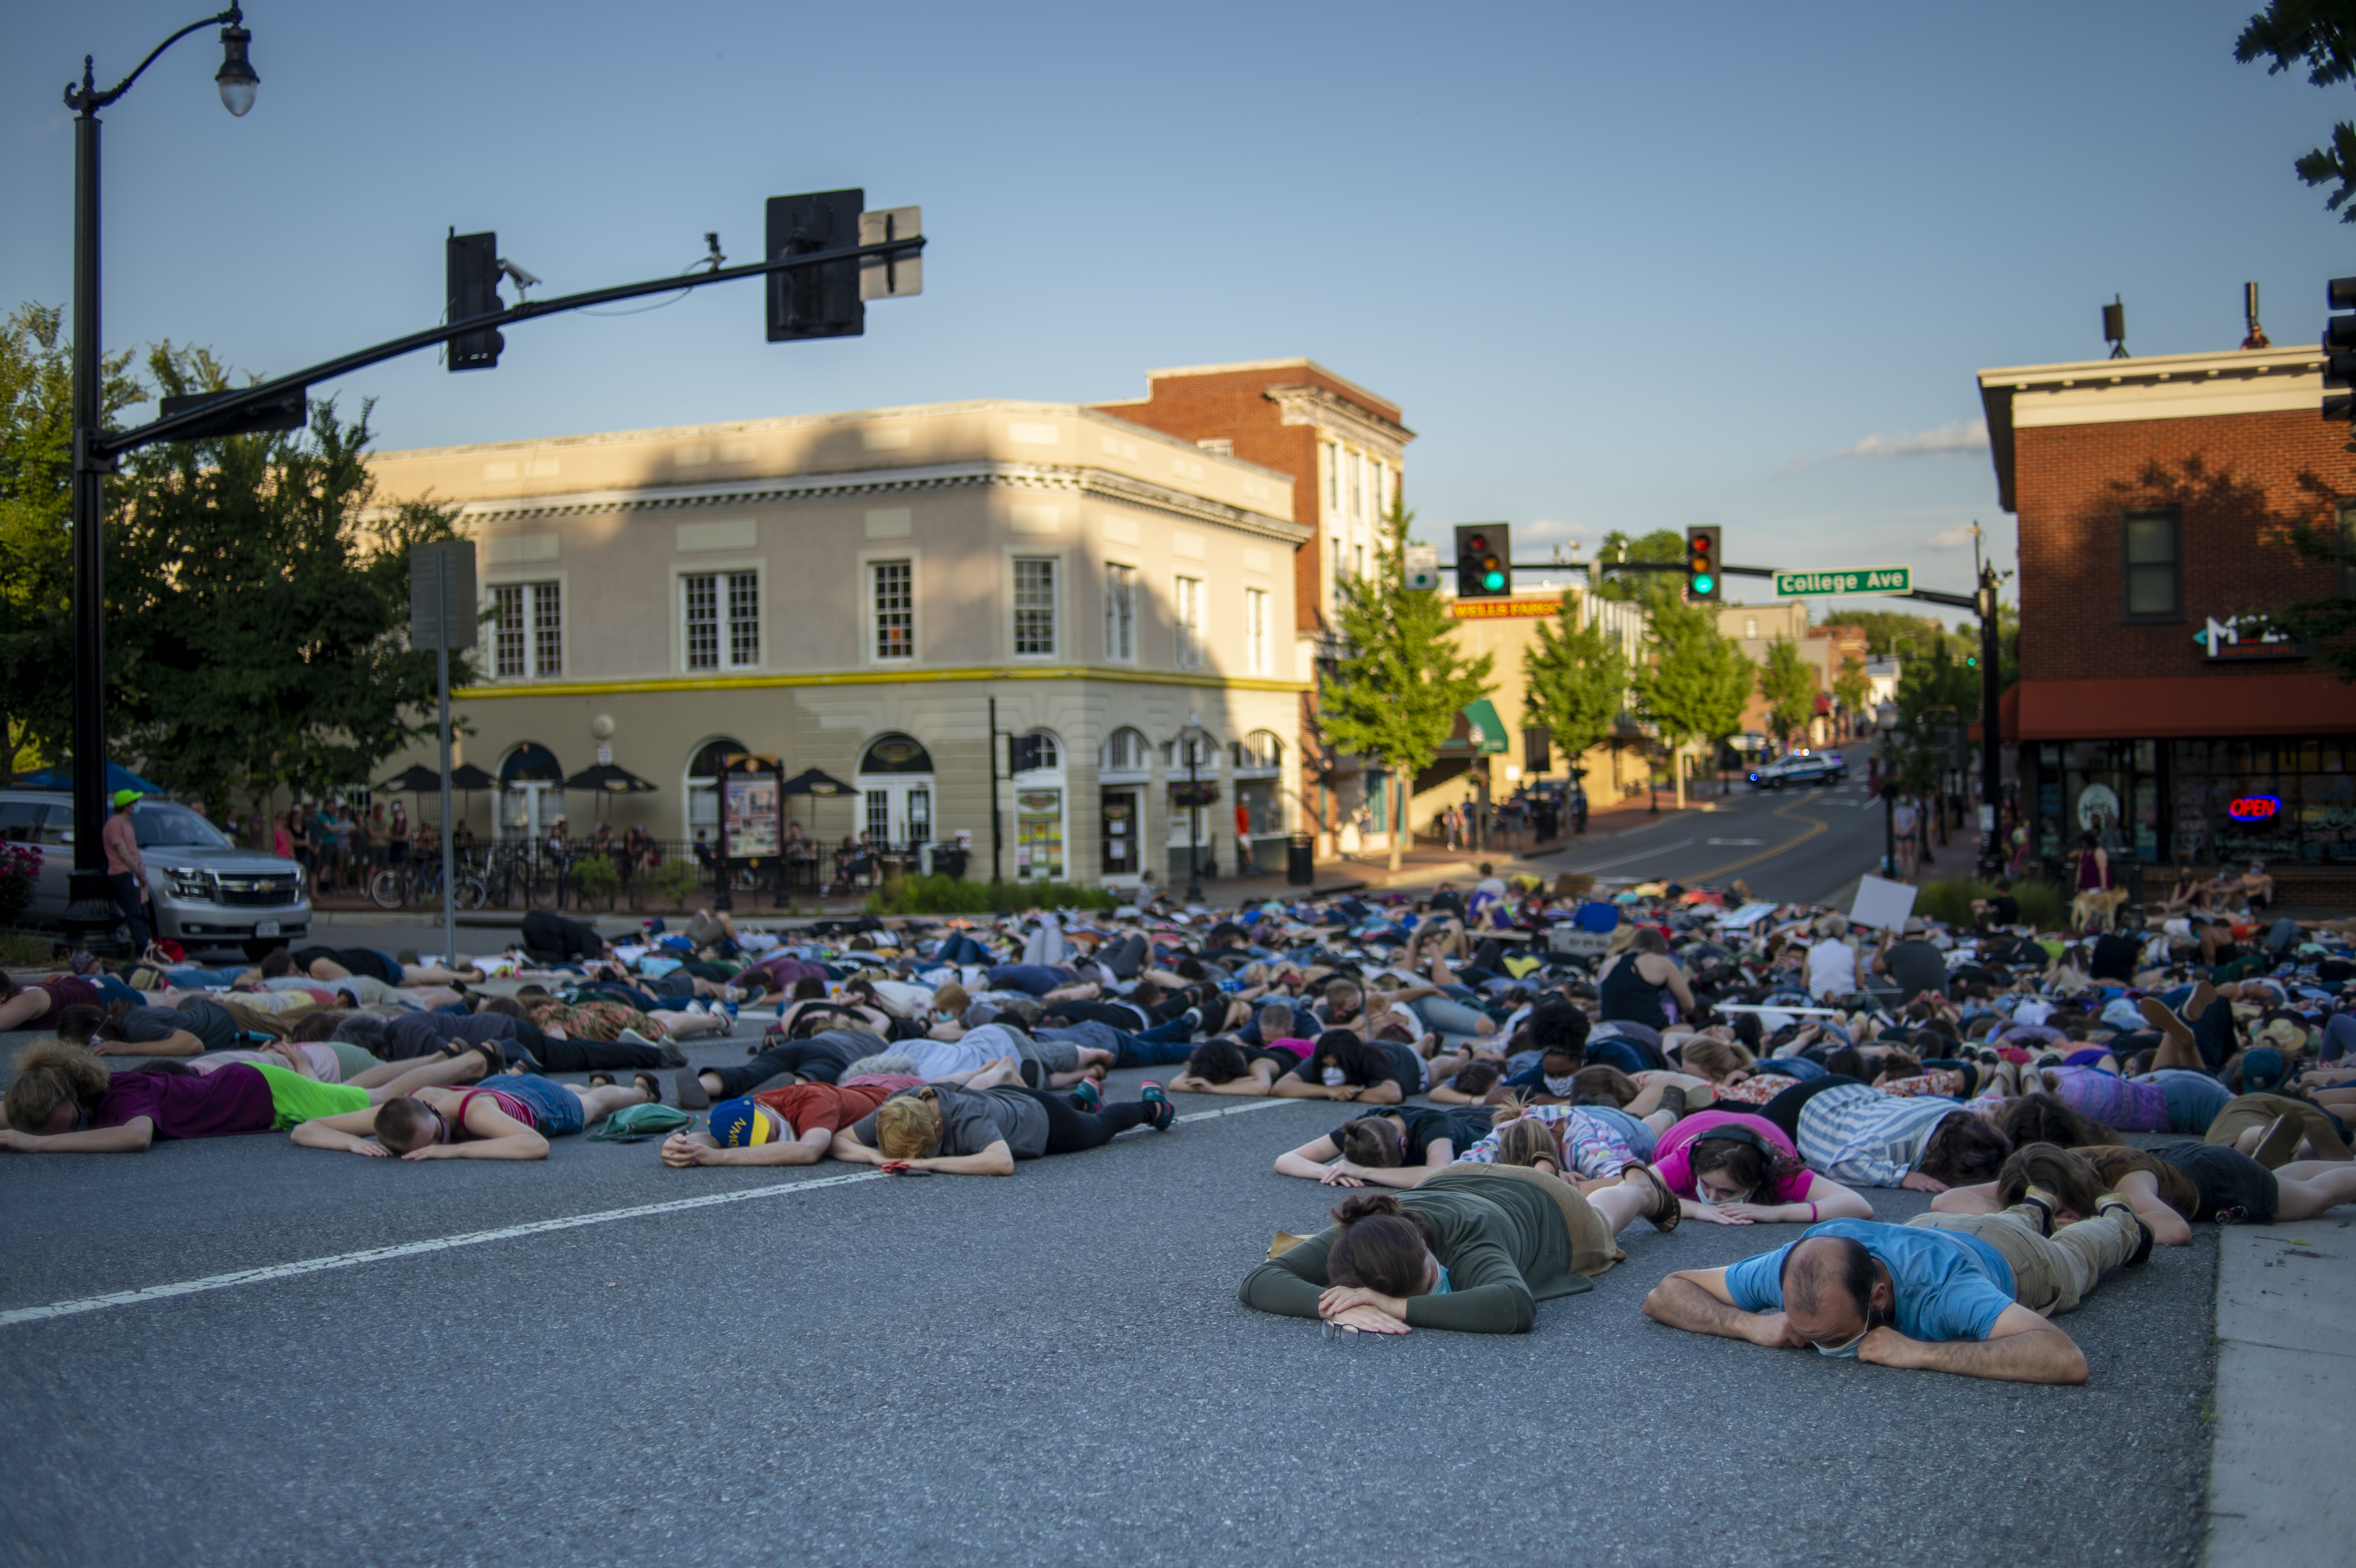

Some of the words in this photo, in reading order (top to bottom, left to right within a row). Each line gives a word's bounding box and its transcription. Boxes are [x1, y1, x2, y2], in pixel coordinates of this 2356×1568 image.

[1781, 574, 1857, 594] College
[1867, 571, 1904, 588] Ave
[1454, 603, 1508, 617] WELLS
[2232, 798, 2276, 817] OPEN
[728, 1117, 747, 1147] OWN
